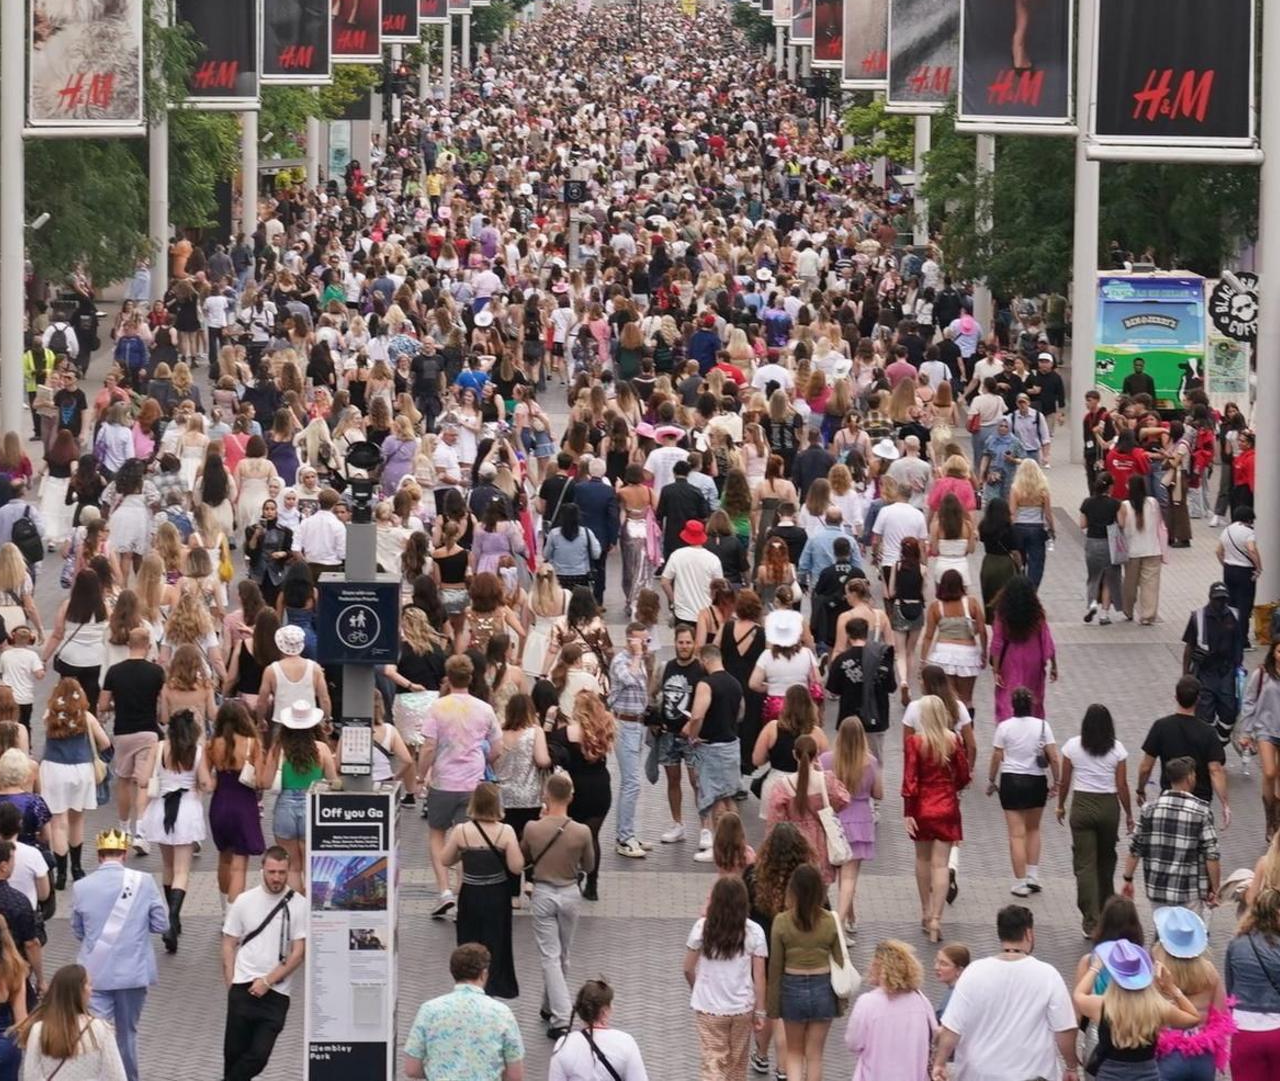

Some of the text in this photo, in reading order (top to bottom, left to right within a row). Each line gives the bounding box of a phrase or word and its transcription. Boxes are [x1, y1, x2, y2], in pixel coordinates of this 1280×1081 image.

[336, 29, 367, 50] H&M
[278, 45, 314, 69] H&M
[192, 60, 238, 89] H&M
[906, 65, 952, 94] H&M
[987, 68, 1045, 107] H&M
[57, 73, 114, 110] H&M
[1133, 68, 1215, 122] H&M
[1215, 284, 1234, 313] BLAC
[1228, 320, 1258, 337] COFF
[321, 807, 342, 818] Off
[344, 809, 365, 820] you
[310, 1045, 352, 1053] Wembley
